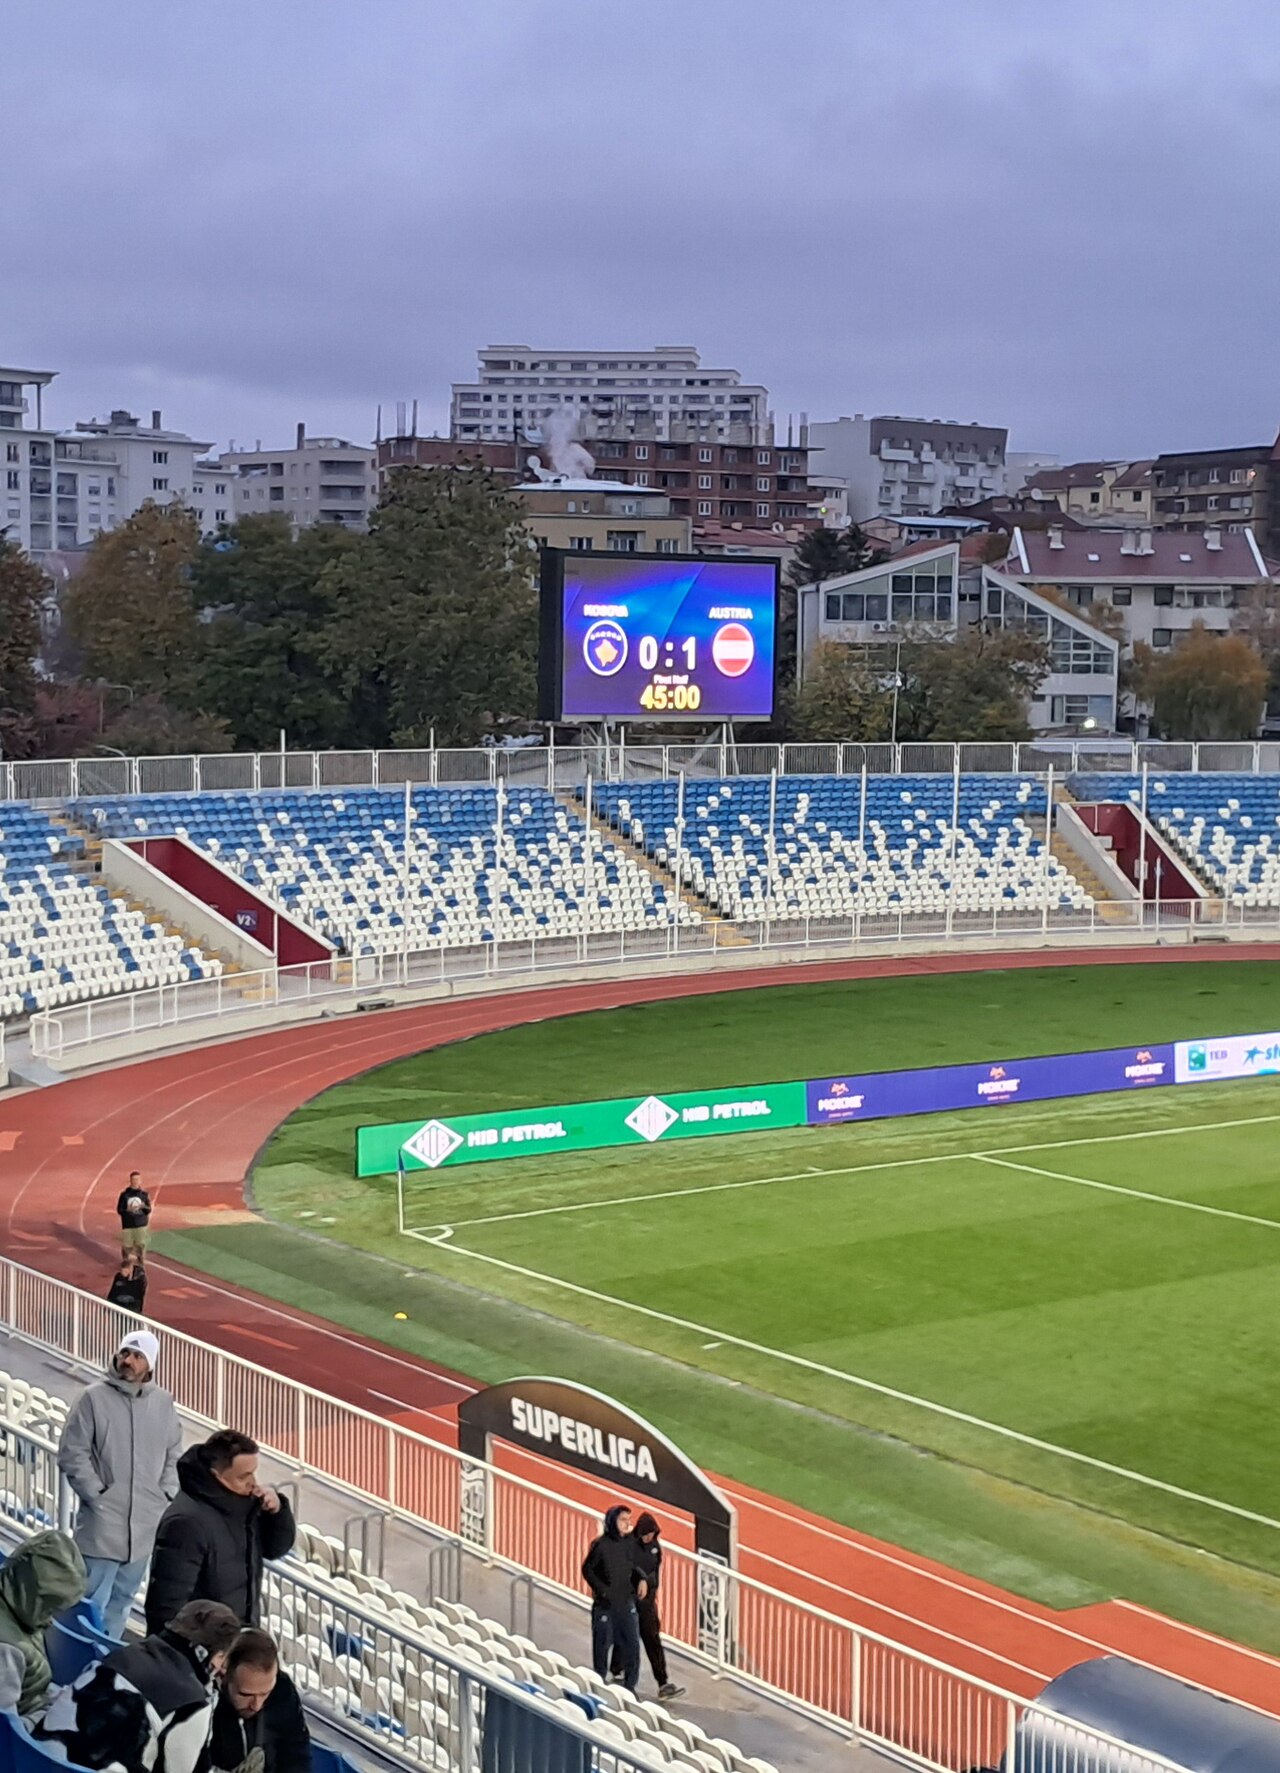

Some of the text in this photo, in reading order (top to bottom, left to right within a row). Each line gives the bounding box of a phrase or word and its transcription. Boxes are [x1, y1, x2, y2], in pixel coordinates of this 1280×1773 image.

[708, 606, 754, 620] AUSTRIA
[639, 684, 701, 710] 45:00
[1209, 1049, 1228, 1060] TEB
[682, 1100, 772, 1123] HIB PETROL
[467, 1120, 568, 1148] HIB PETROL
[510, 1396, 659, 1484] SUPERLIGA
